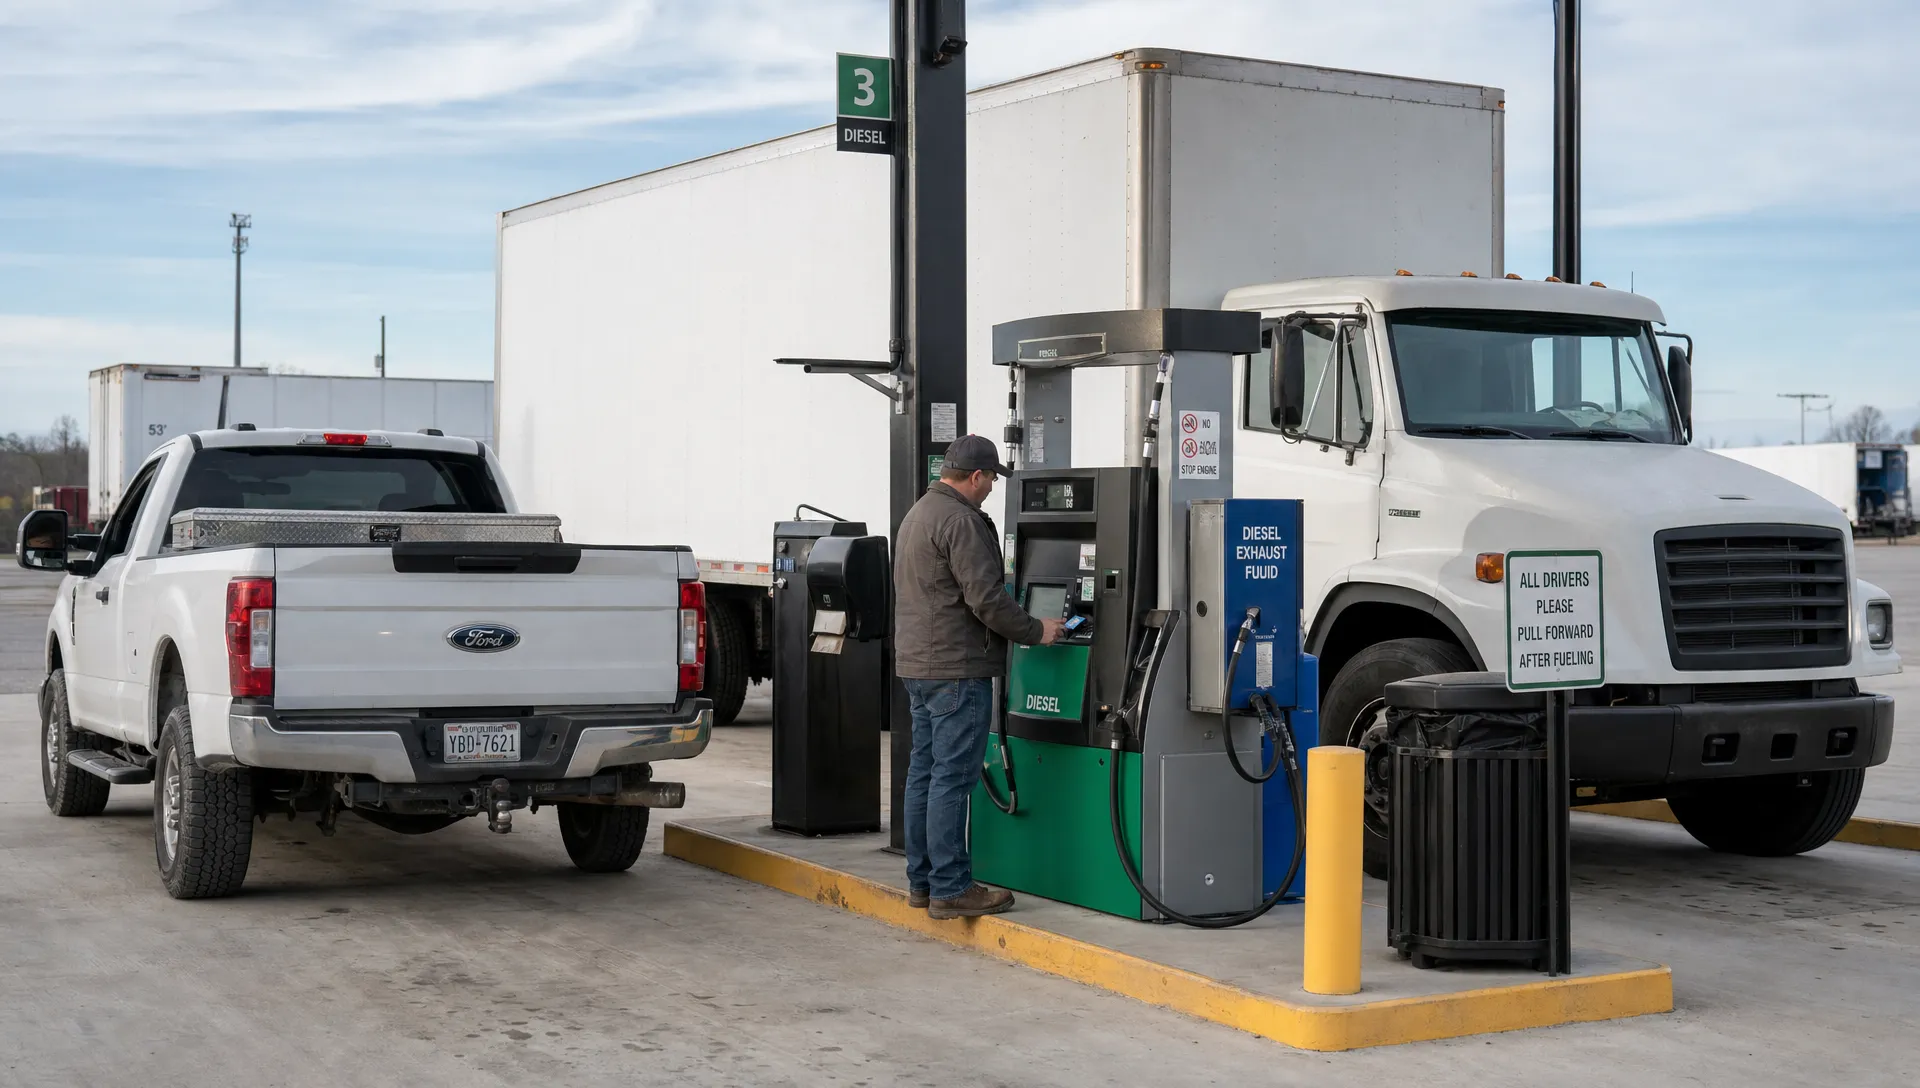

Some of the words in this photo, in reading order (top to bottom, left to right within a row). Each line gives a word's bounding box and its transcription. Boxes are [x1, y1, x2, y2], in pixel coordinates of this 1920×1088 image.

[853, 67, 876, 107] 3
[844, 128, 886, 145] DIESEL
[1202, 419, 1211, 429] NO
[1242, 526, 1281, 540] DIESEL
[1236, 545, 1287, 560] EXHAUST
[1520, 572, 1540, 588] ALL
[1543, 571, 1590, 588] DRIVERS
[1536, 598, 1574, 614] PLEASE
[464, 629, 505, 647] Ford
[1517, 626, 1542, 641] PULL
[1545, 624, 1594, 640] FORWARD
[1519, 653, 1551, 668] AFTER
[1553, 650, 1594, 667] FUELING
[1026, 694, 1060, 713] DIESEL
[449, 734, 516, 754] YBD-7621
